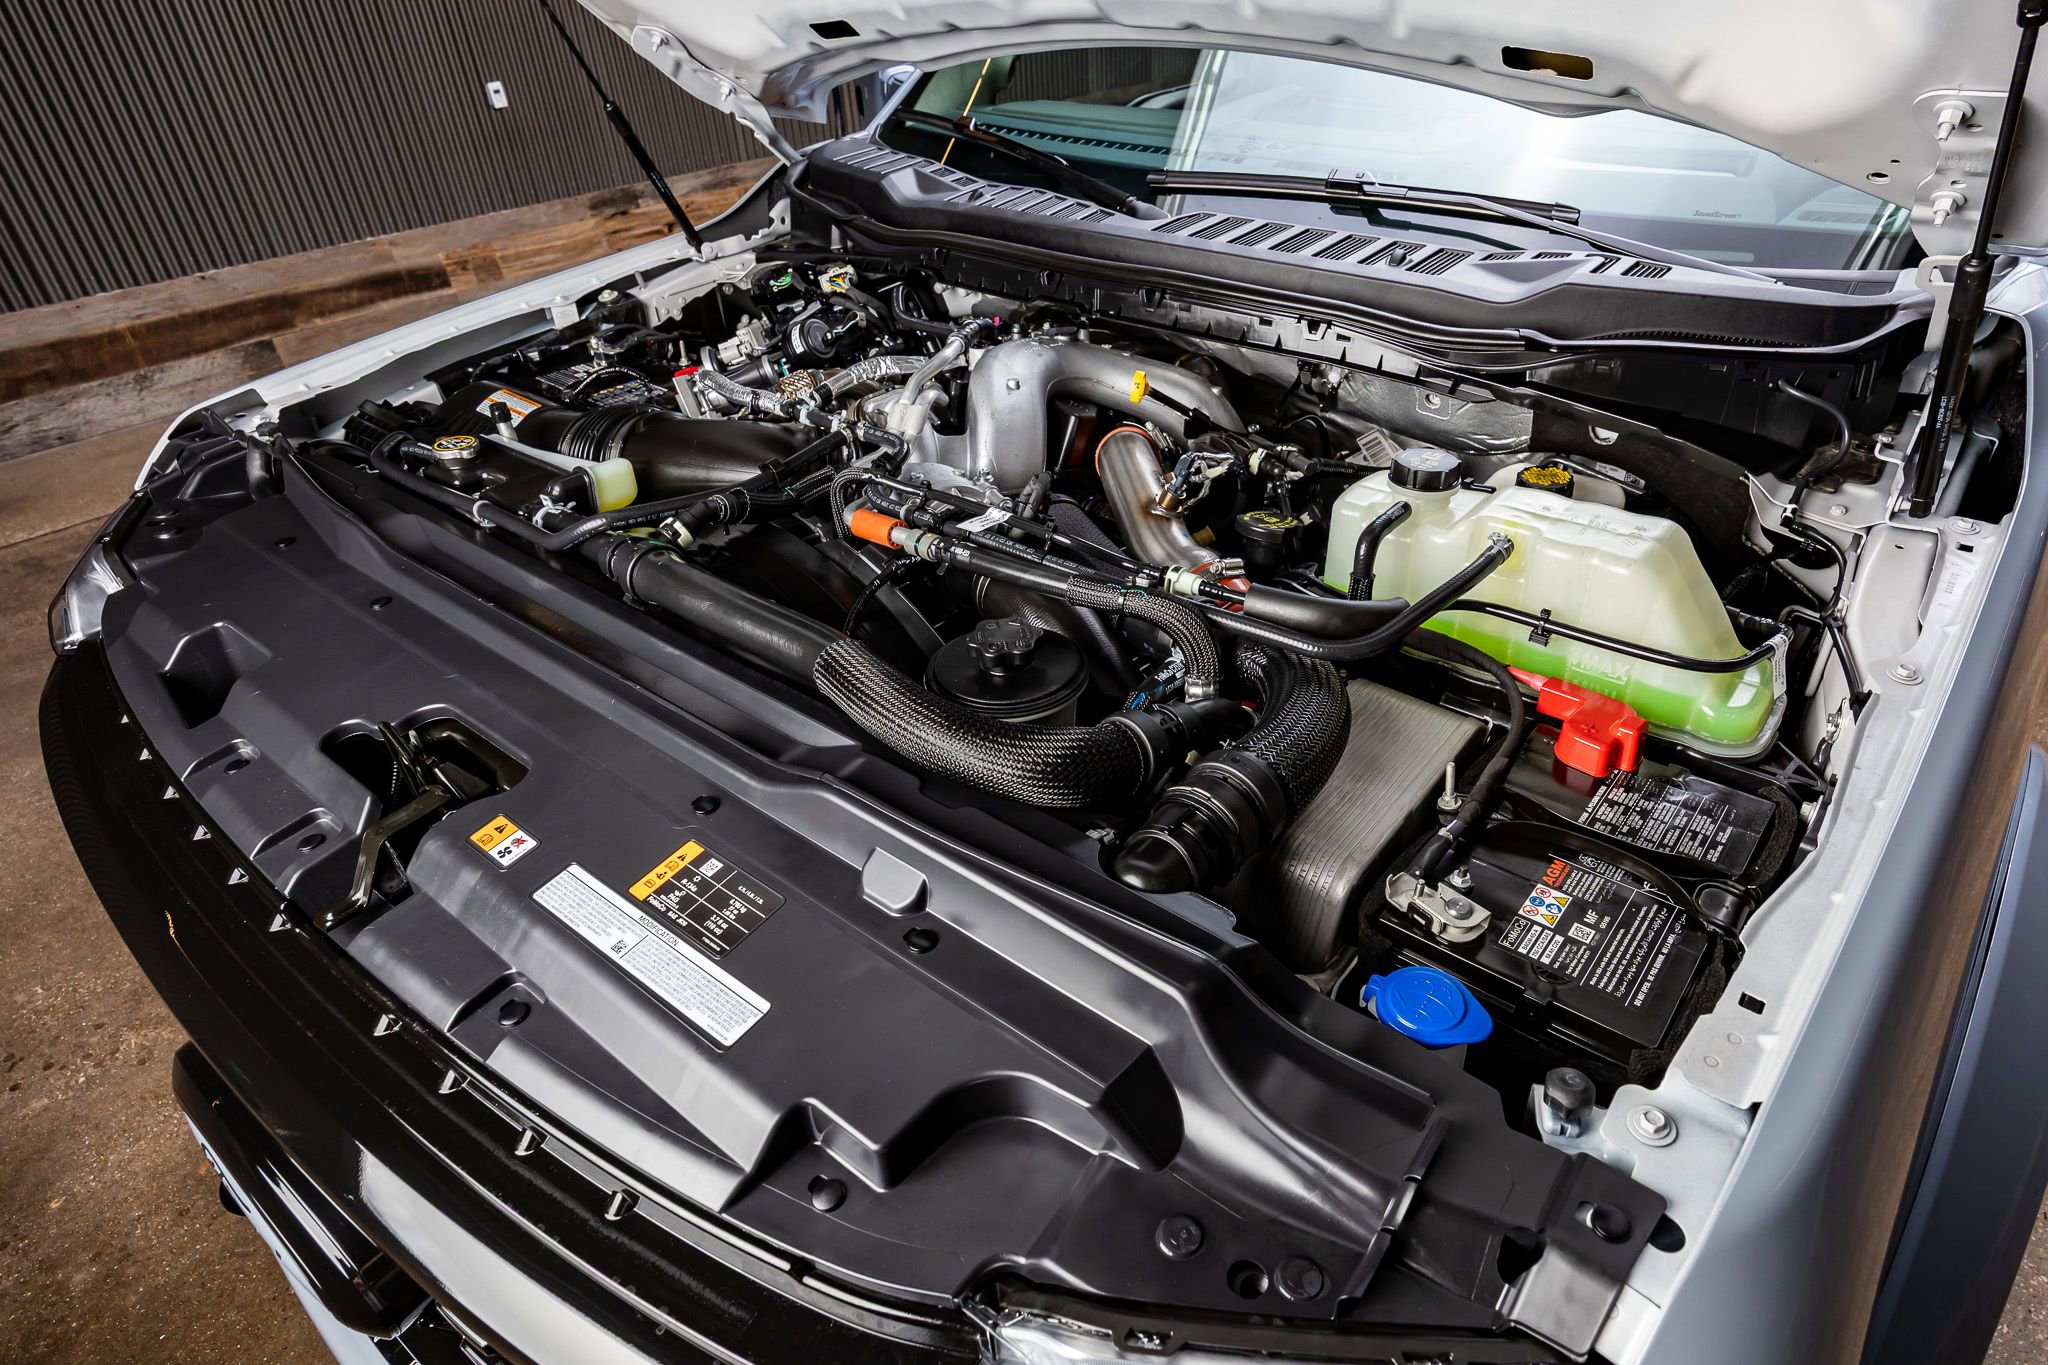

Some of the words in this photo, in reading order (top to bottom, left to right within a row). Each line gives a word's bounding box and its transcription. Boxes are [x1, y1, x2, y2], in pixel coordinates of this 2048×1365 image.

[1543, 860, 1565, 885] AGM
[681, 879, 697, 892] R-134a
[647, 896, 666, 911] FoMoCo
[668, 893, 679, 902] PAG
[1584, 910, 1598, 924] MF
[638, 915, 680, 947] MODIFICATION
[1503, 920, 1525, 947] FoMoCo
